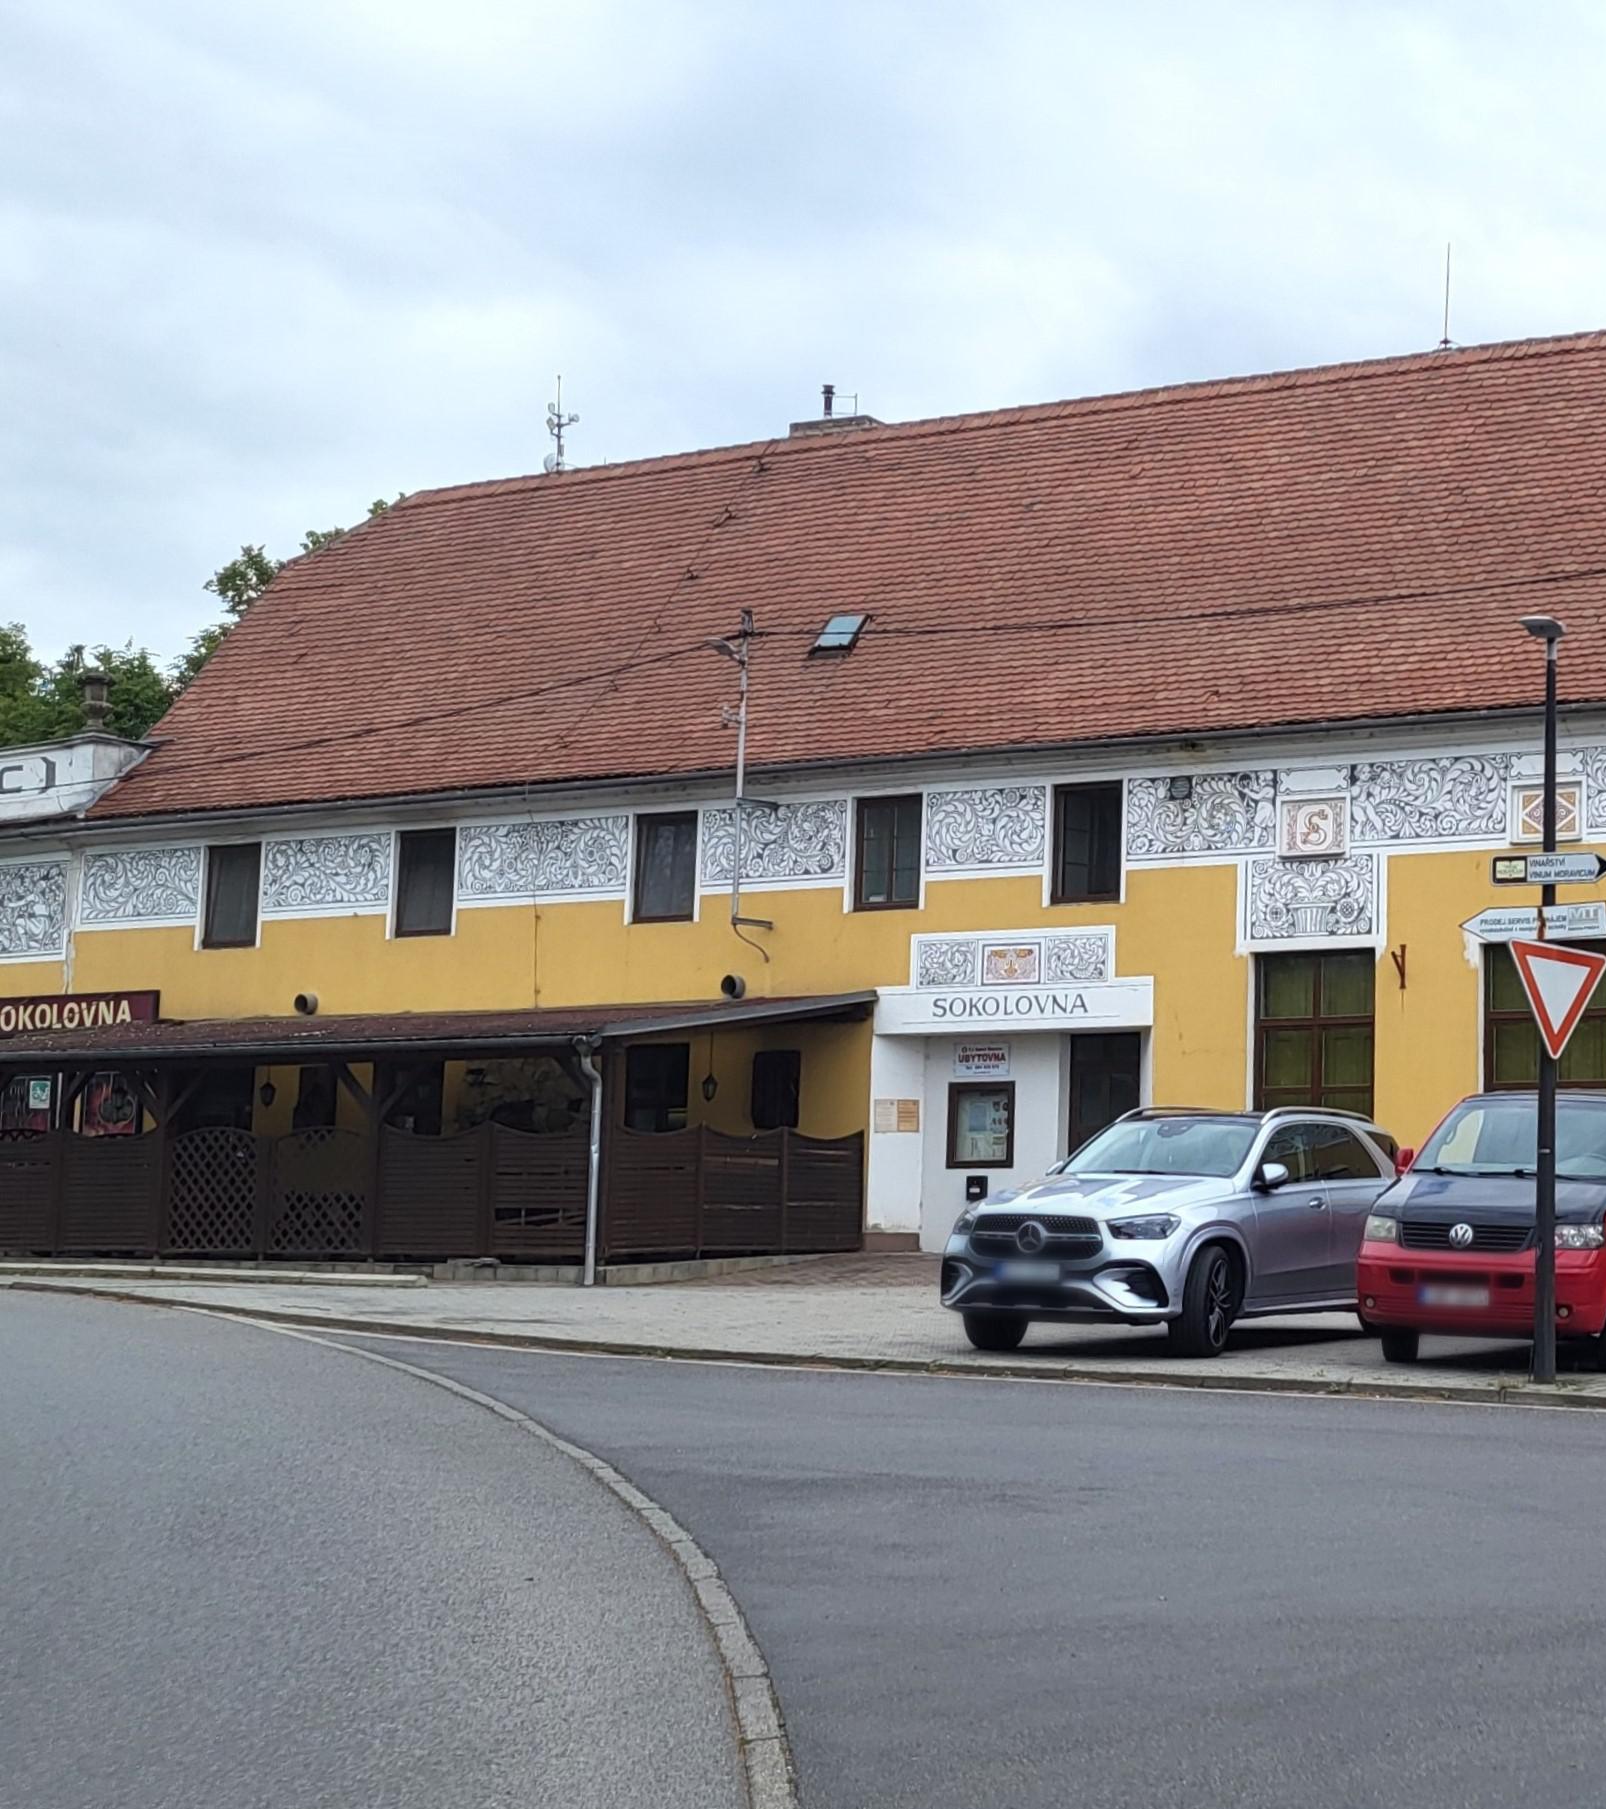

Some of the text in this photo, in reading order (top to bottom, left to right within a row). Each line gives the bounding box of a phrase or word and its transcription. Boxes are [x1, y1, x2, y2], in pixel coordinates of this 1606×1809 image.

[1529, 857, 1565, 867] VINAŘSTVÍ
[1529, 868, 1595, 880] VINUM MORAVICUM
[932, 993, 1088, 1018] SOKOLOVNA
[958, 1052, 1006, 1063] UBYTOVNA
